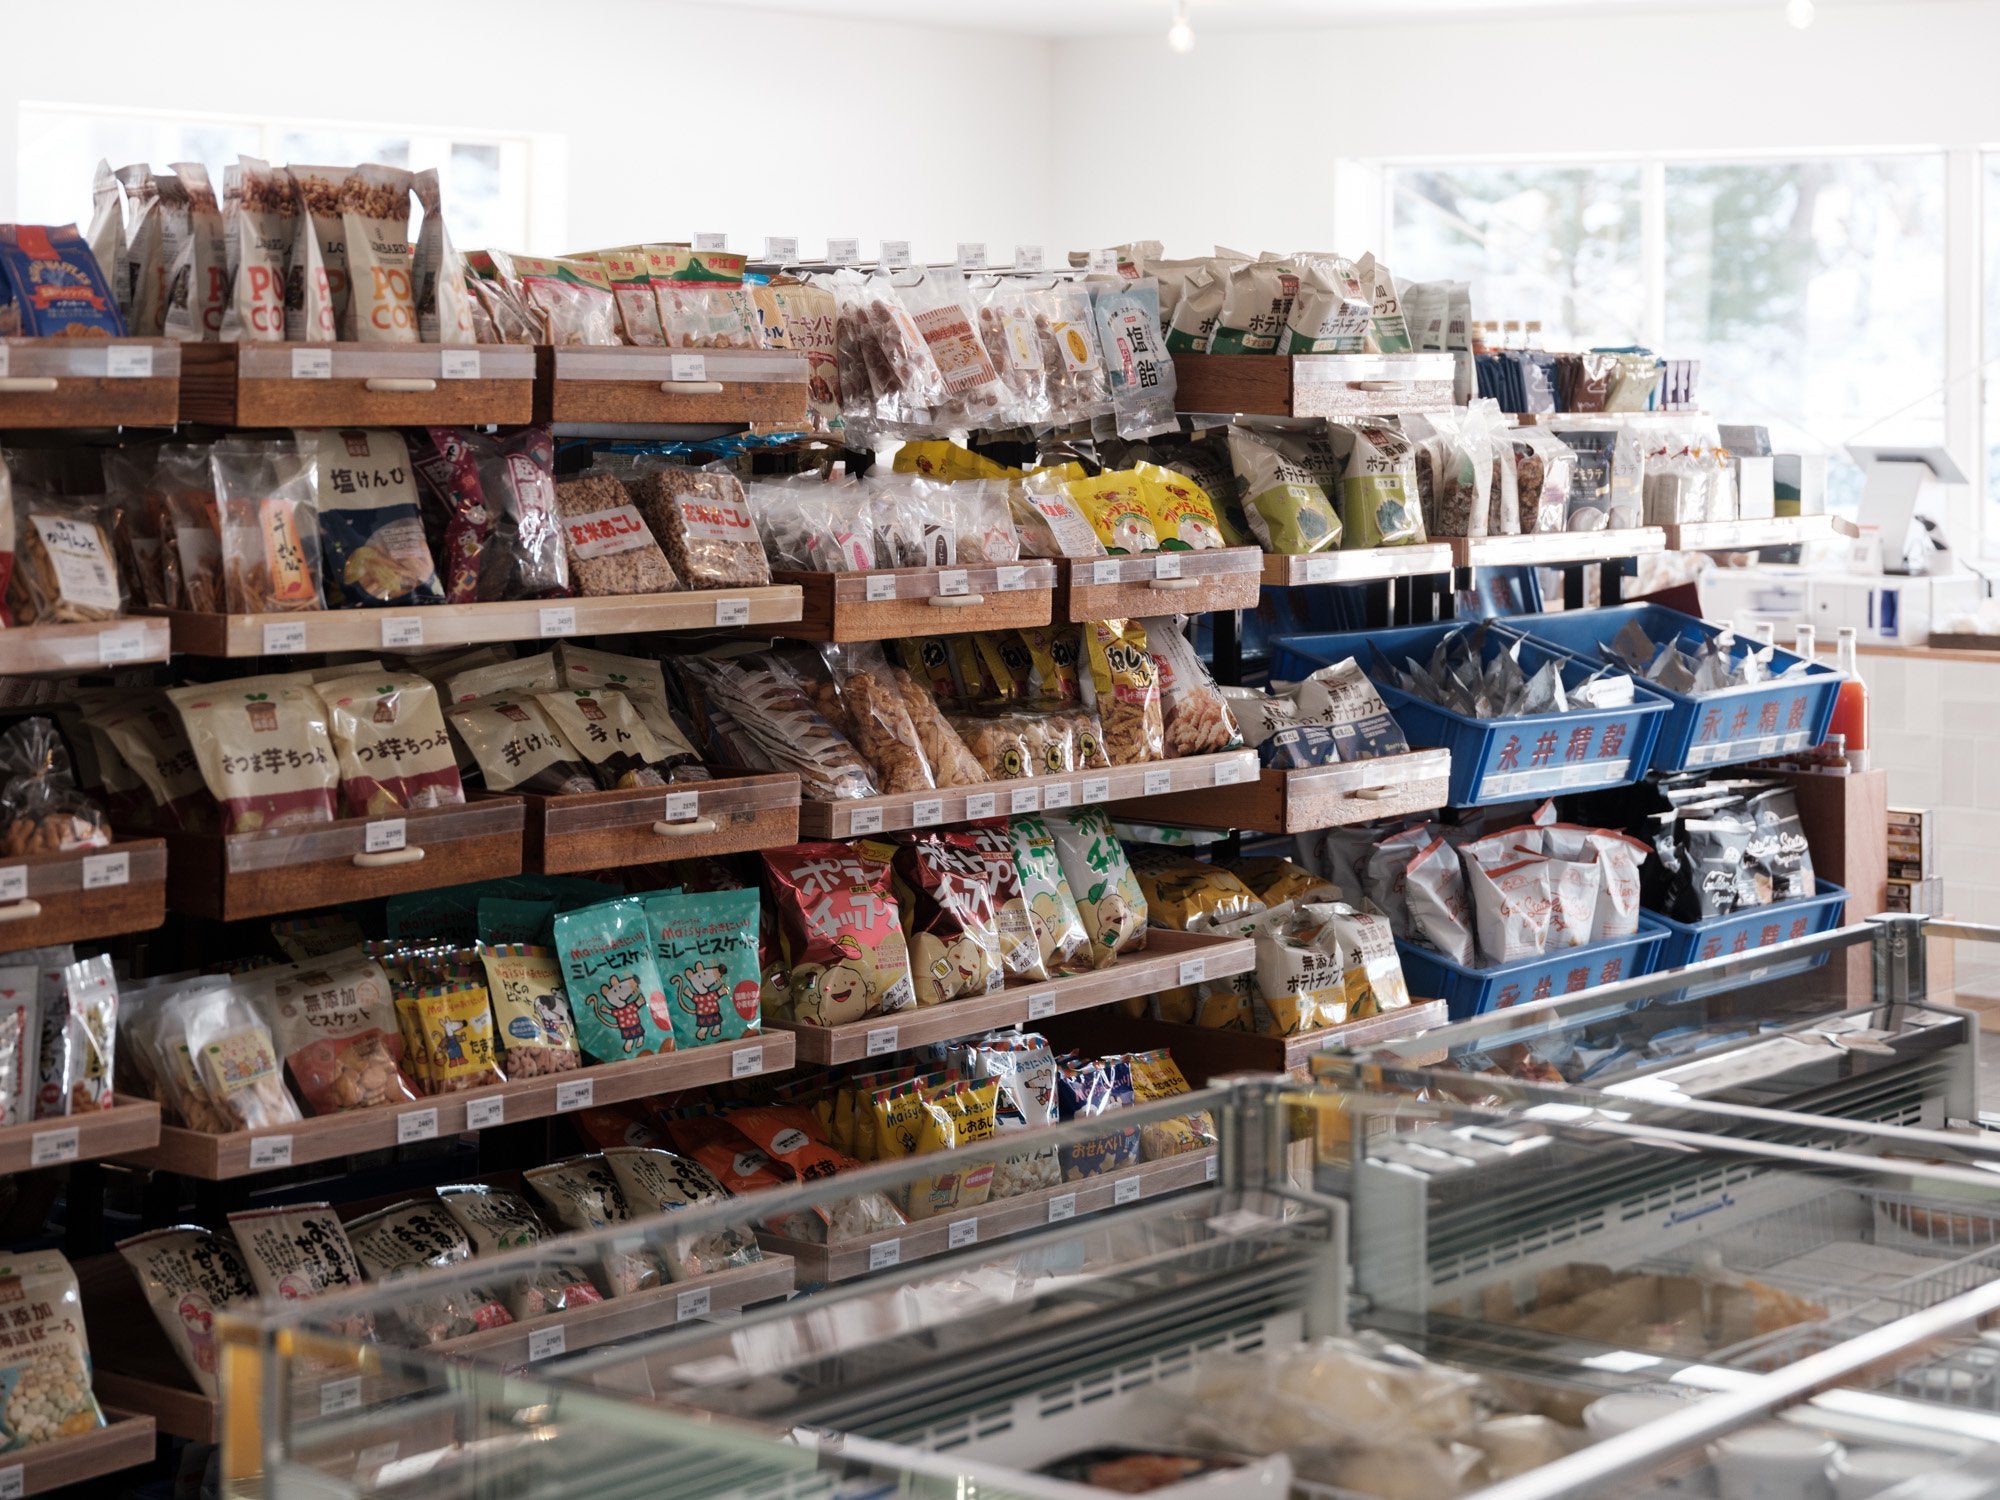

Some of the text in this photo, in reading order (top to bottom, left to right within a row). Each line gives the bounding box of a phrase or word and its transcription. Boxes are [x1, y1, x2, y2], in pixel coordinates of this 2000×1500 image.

[568, 513, 643, 546] 玄米おこし
[681, 502, 750, 529] 玄米おこし
